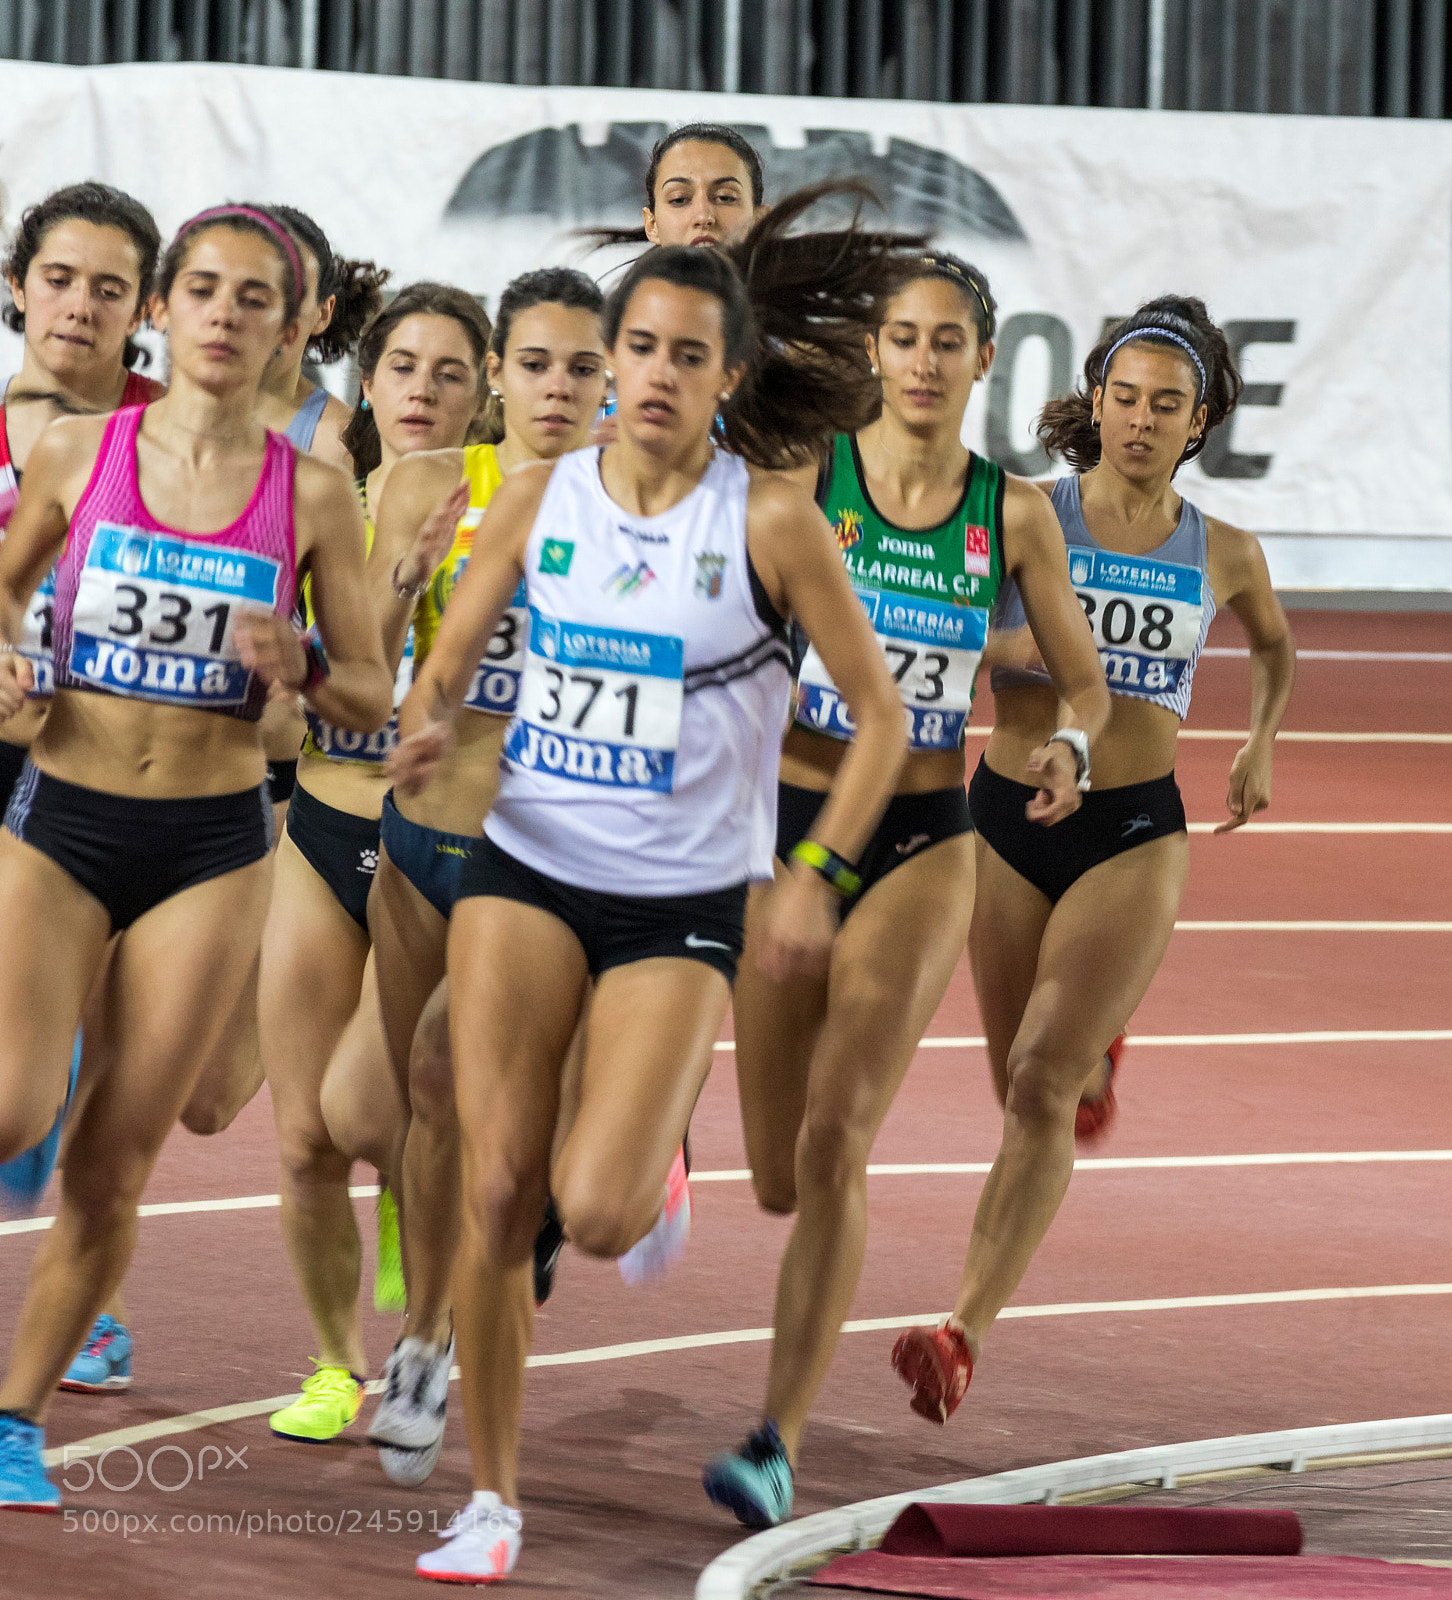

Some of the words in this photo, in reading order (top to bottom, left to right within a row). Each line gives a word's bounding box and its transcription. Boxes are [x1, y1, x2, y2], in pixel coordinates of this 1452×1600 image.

[842, 550, 949, 594] ILLARREAL
[878, 535, 935, 561] Joma
[1100, 562, 1176, 586] LOTERÍAS
[108, 584, 230, 654] 331
[85, 640, 230, 695] Joma
[884, 644, 950, 701] 73
[540, 666, 640, 737] 371
[520, 727, 652, 785] Joma
